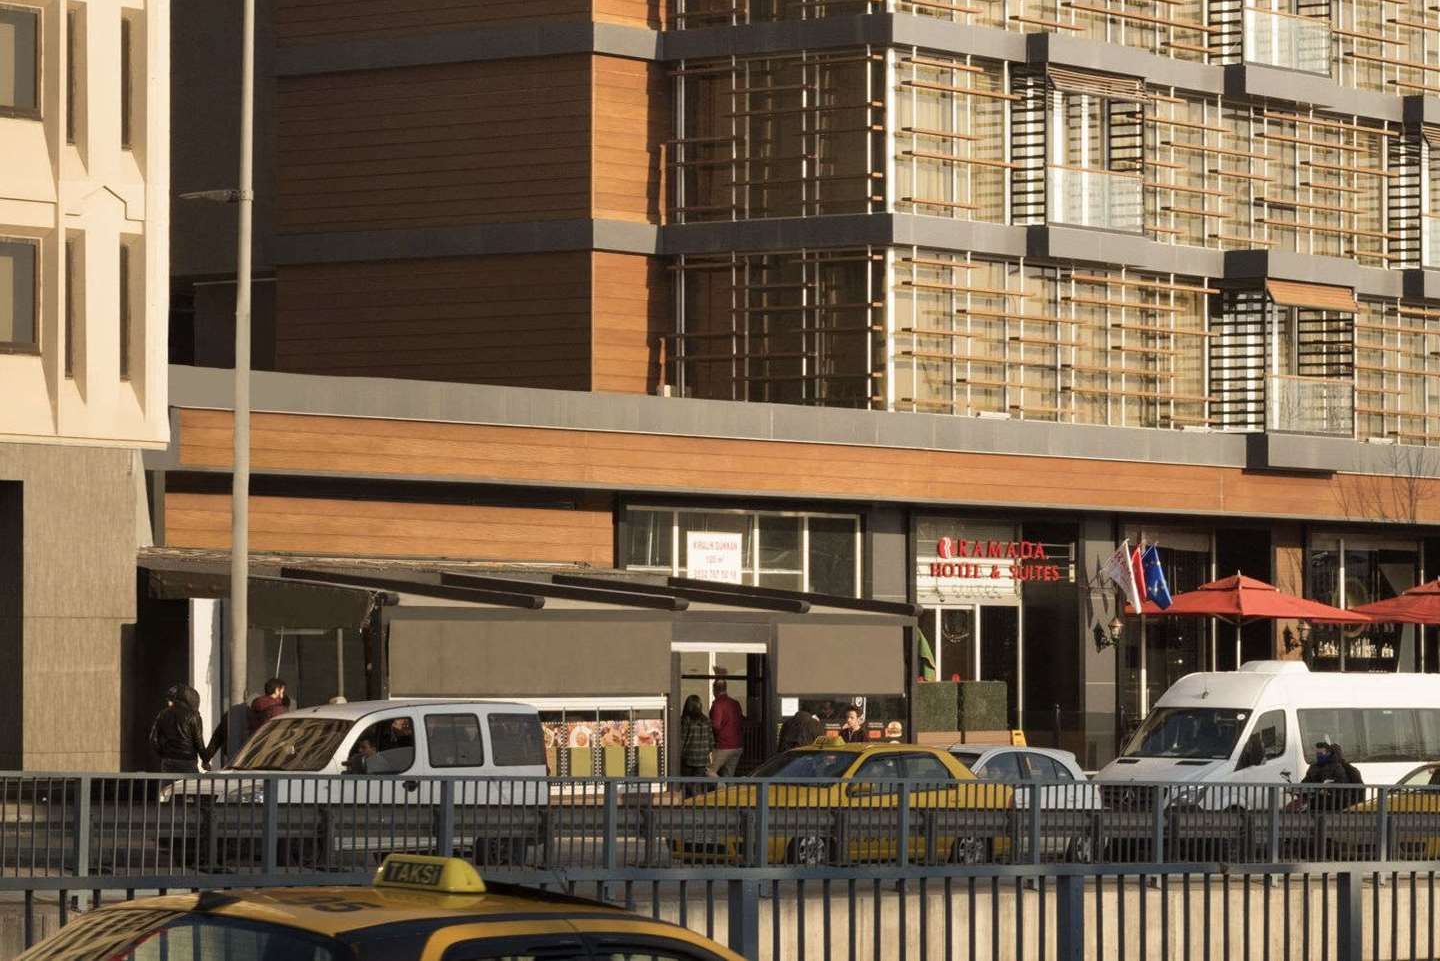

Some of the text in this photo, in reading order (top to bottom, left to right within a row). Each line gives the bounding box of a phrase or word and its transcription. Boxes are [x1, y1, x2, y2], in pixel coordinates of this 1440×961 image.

[957, 539, 1045, 560] RAMADA
[930, 563, 1061, 581] HOTEL & SUITES
